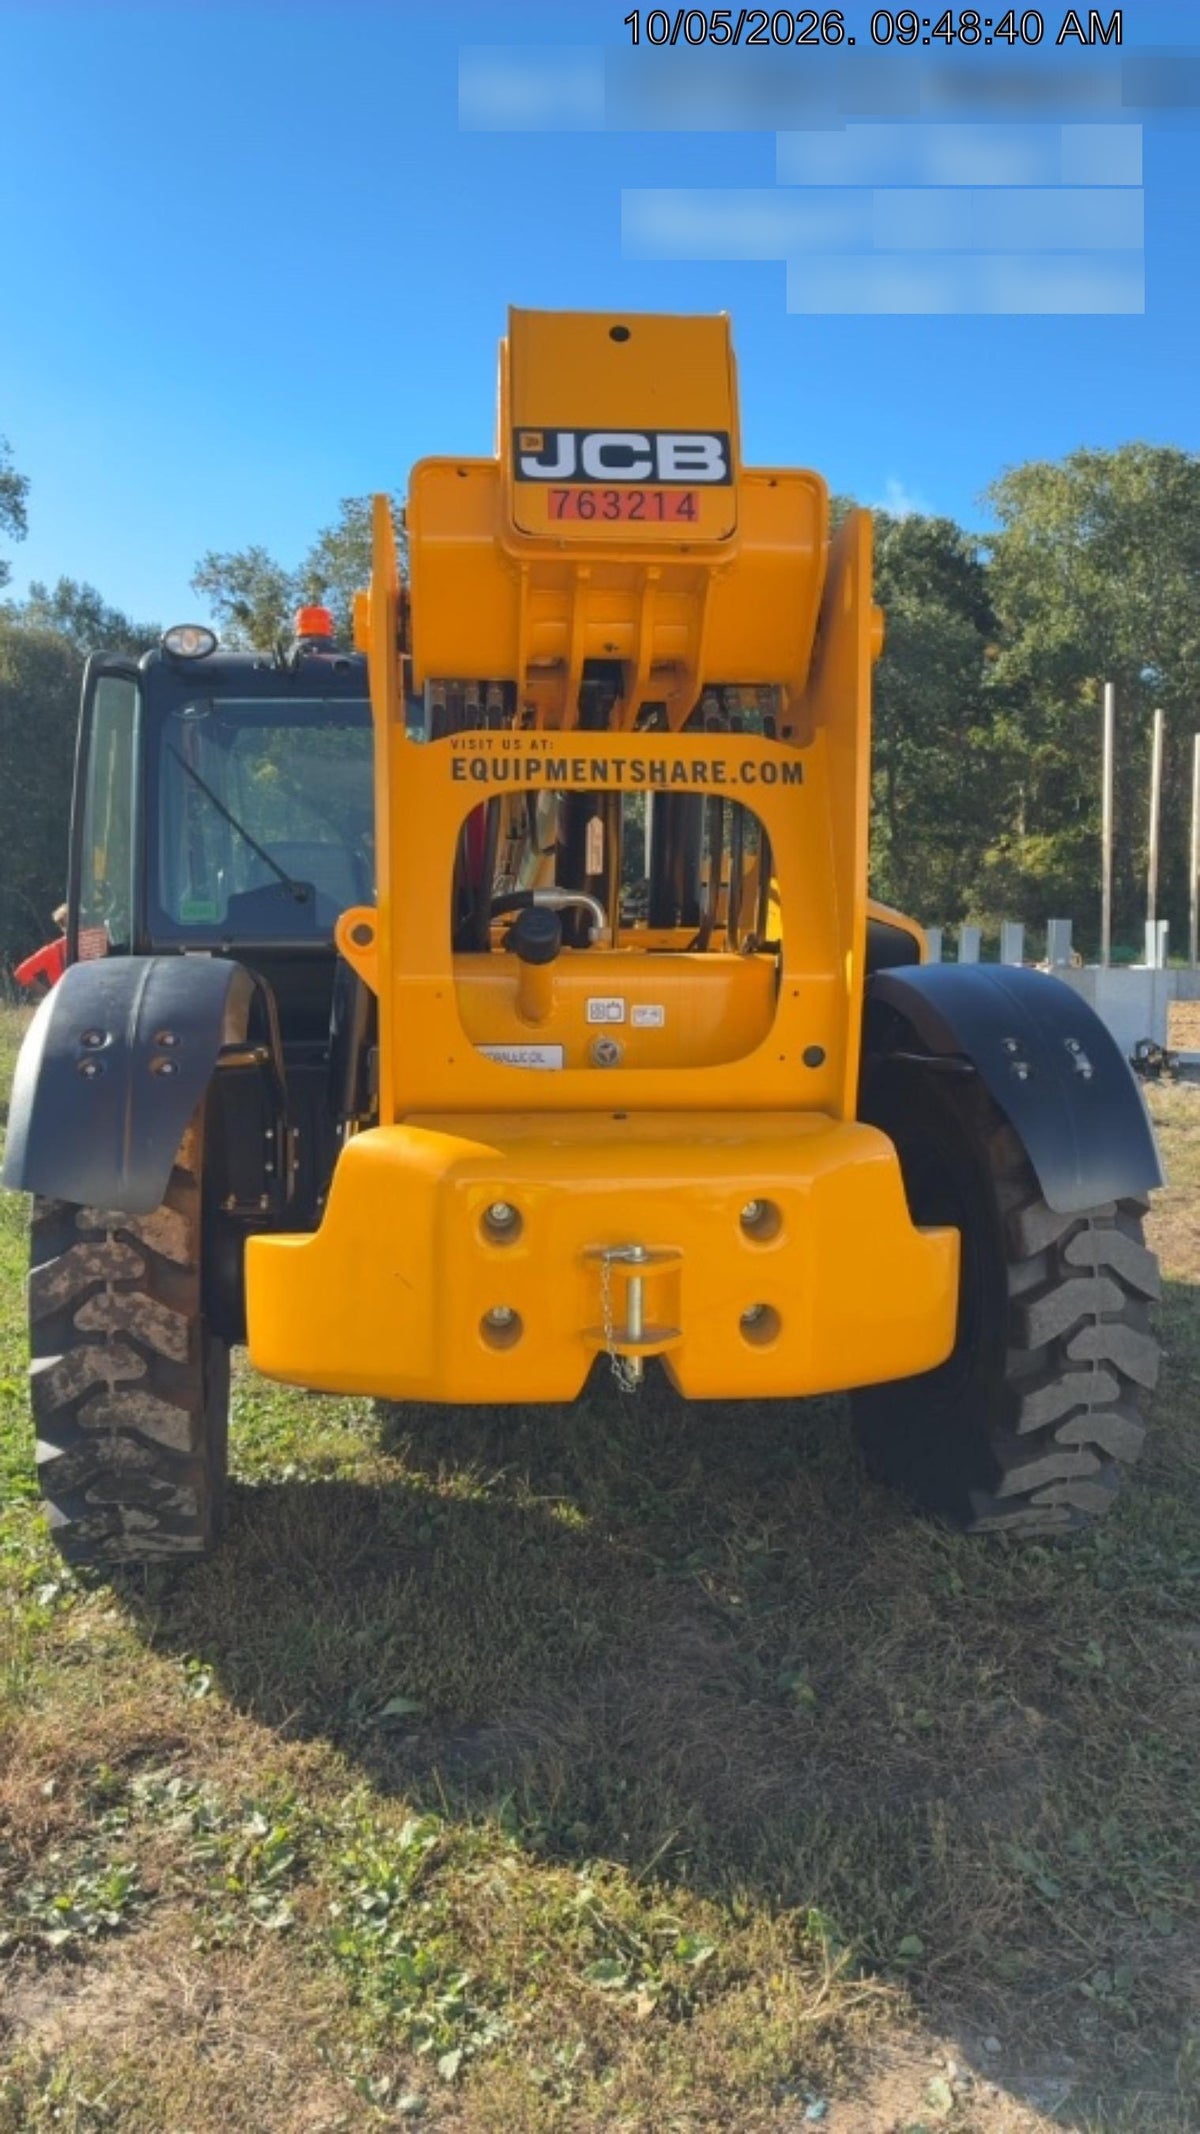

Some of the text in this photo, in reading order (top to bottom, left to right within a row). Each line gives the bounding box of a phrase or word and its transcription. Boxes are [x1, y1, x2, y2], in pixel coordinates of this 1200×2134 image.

[520, 433, 727, 480] JCB
[552, 490, 696, 521] 763214
[450, 739, 554, 750] VISIT US AT:
[452, 758, 803, 784] EQUIPMENTSHARE.COM
